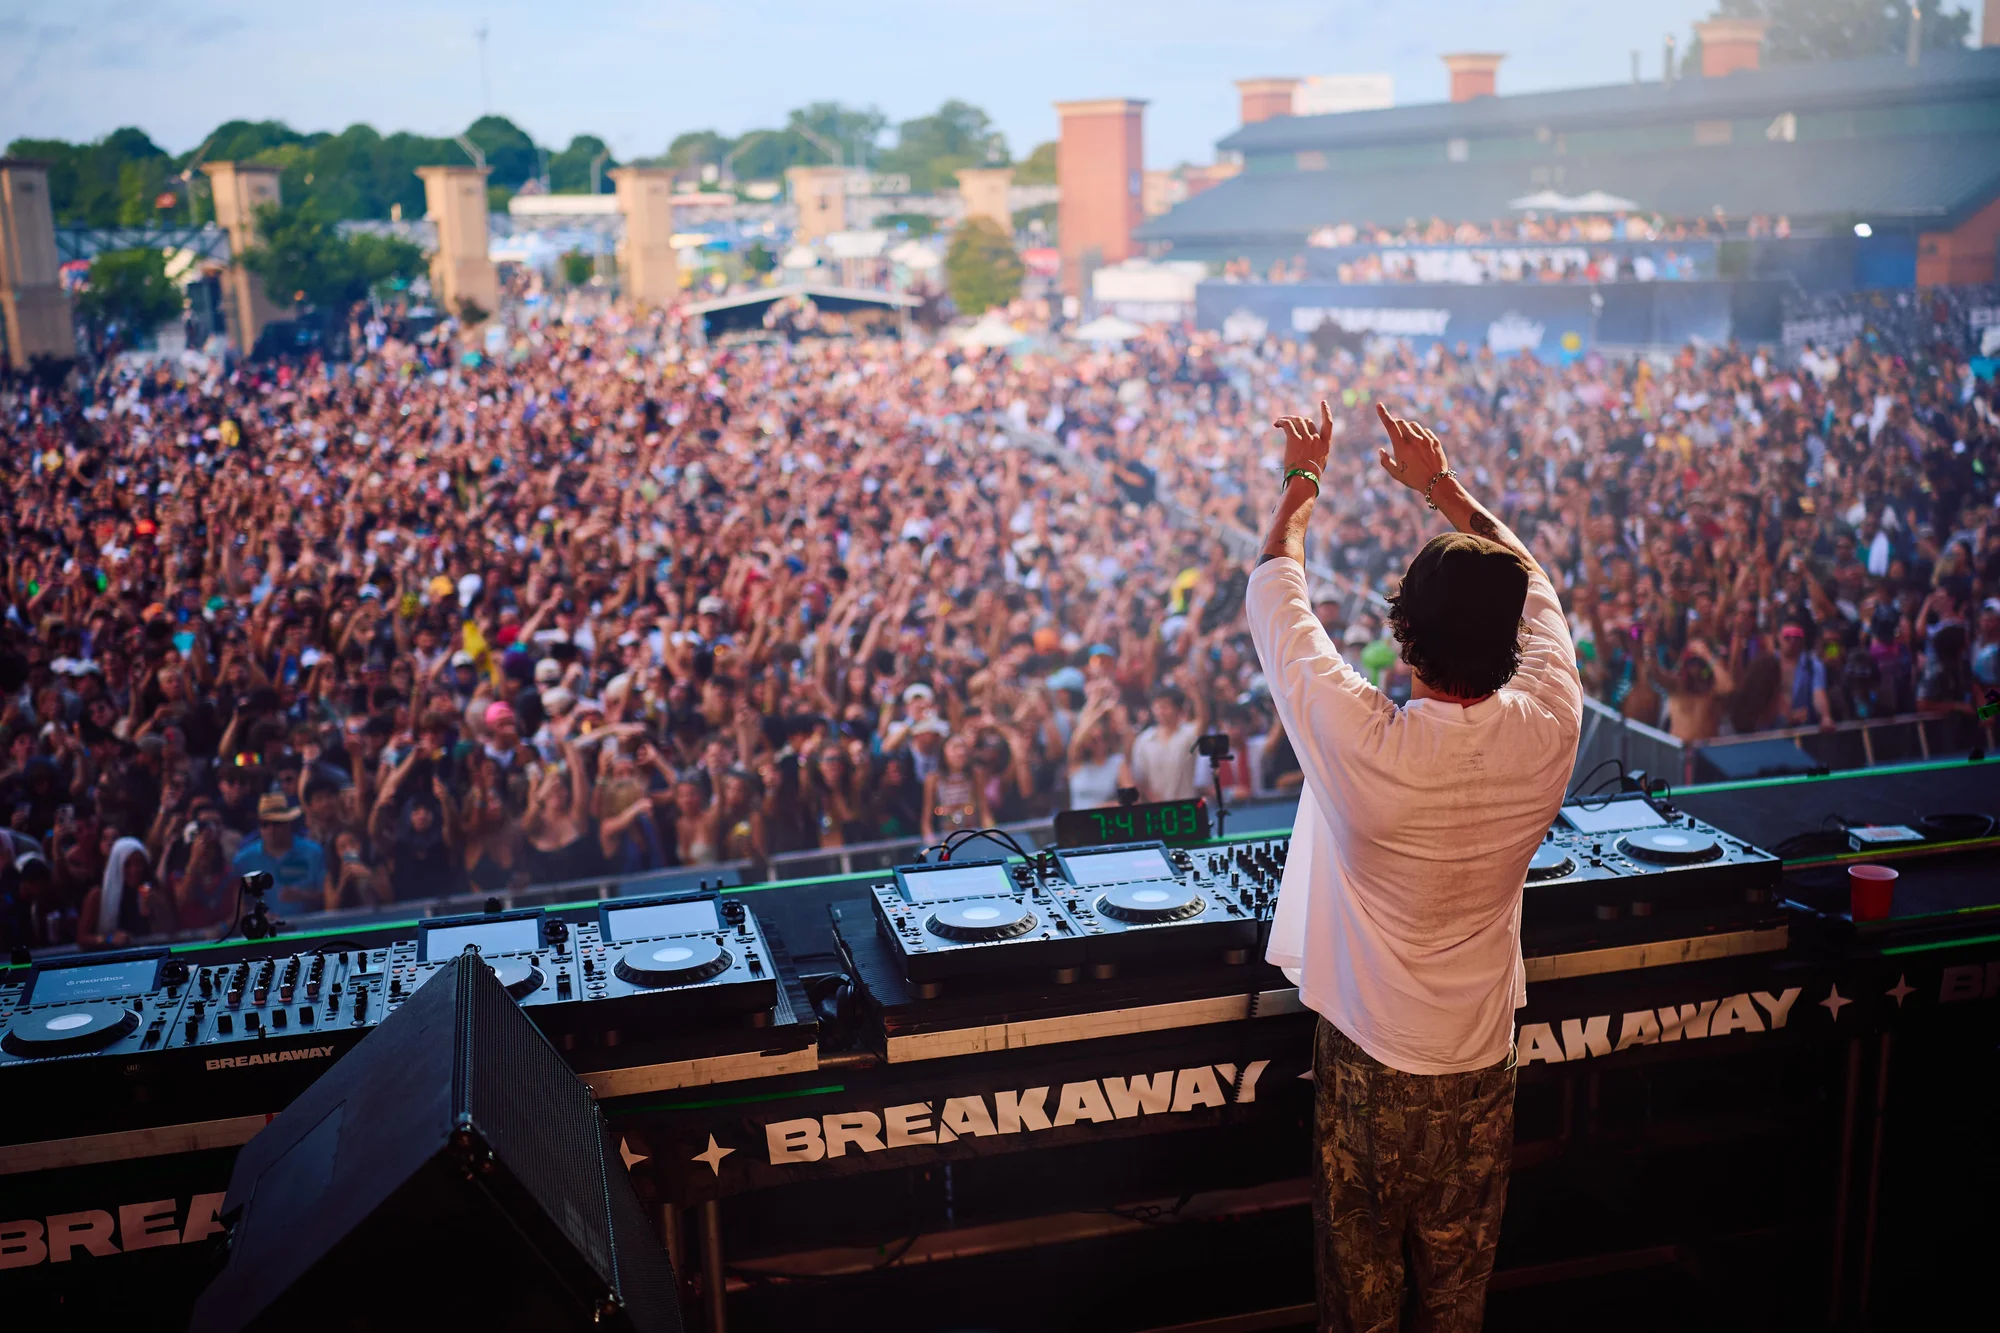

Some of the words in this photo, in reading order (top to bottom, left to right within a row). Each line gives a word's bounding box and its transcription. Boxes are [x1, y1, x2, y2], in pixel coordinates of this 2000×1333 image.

[1091, 804, 1198, 841] 7:41:03
[75, 975, 125, 985] rekordbox
[205, 1045, 335, 1071] BREAKAWAY
[764, 1059, 1271, 1166] BREAKAWAY
